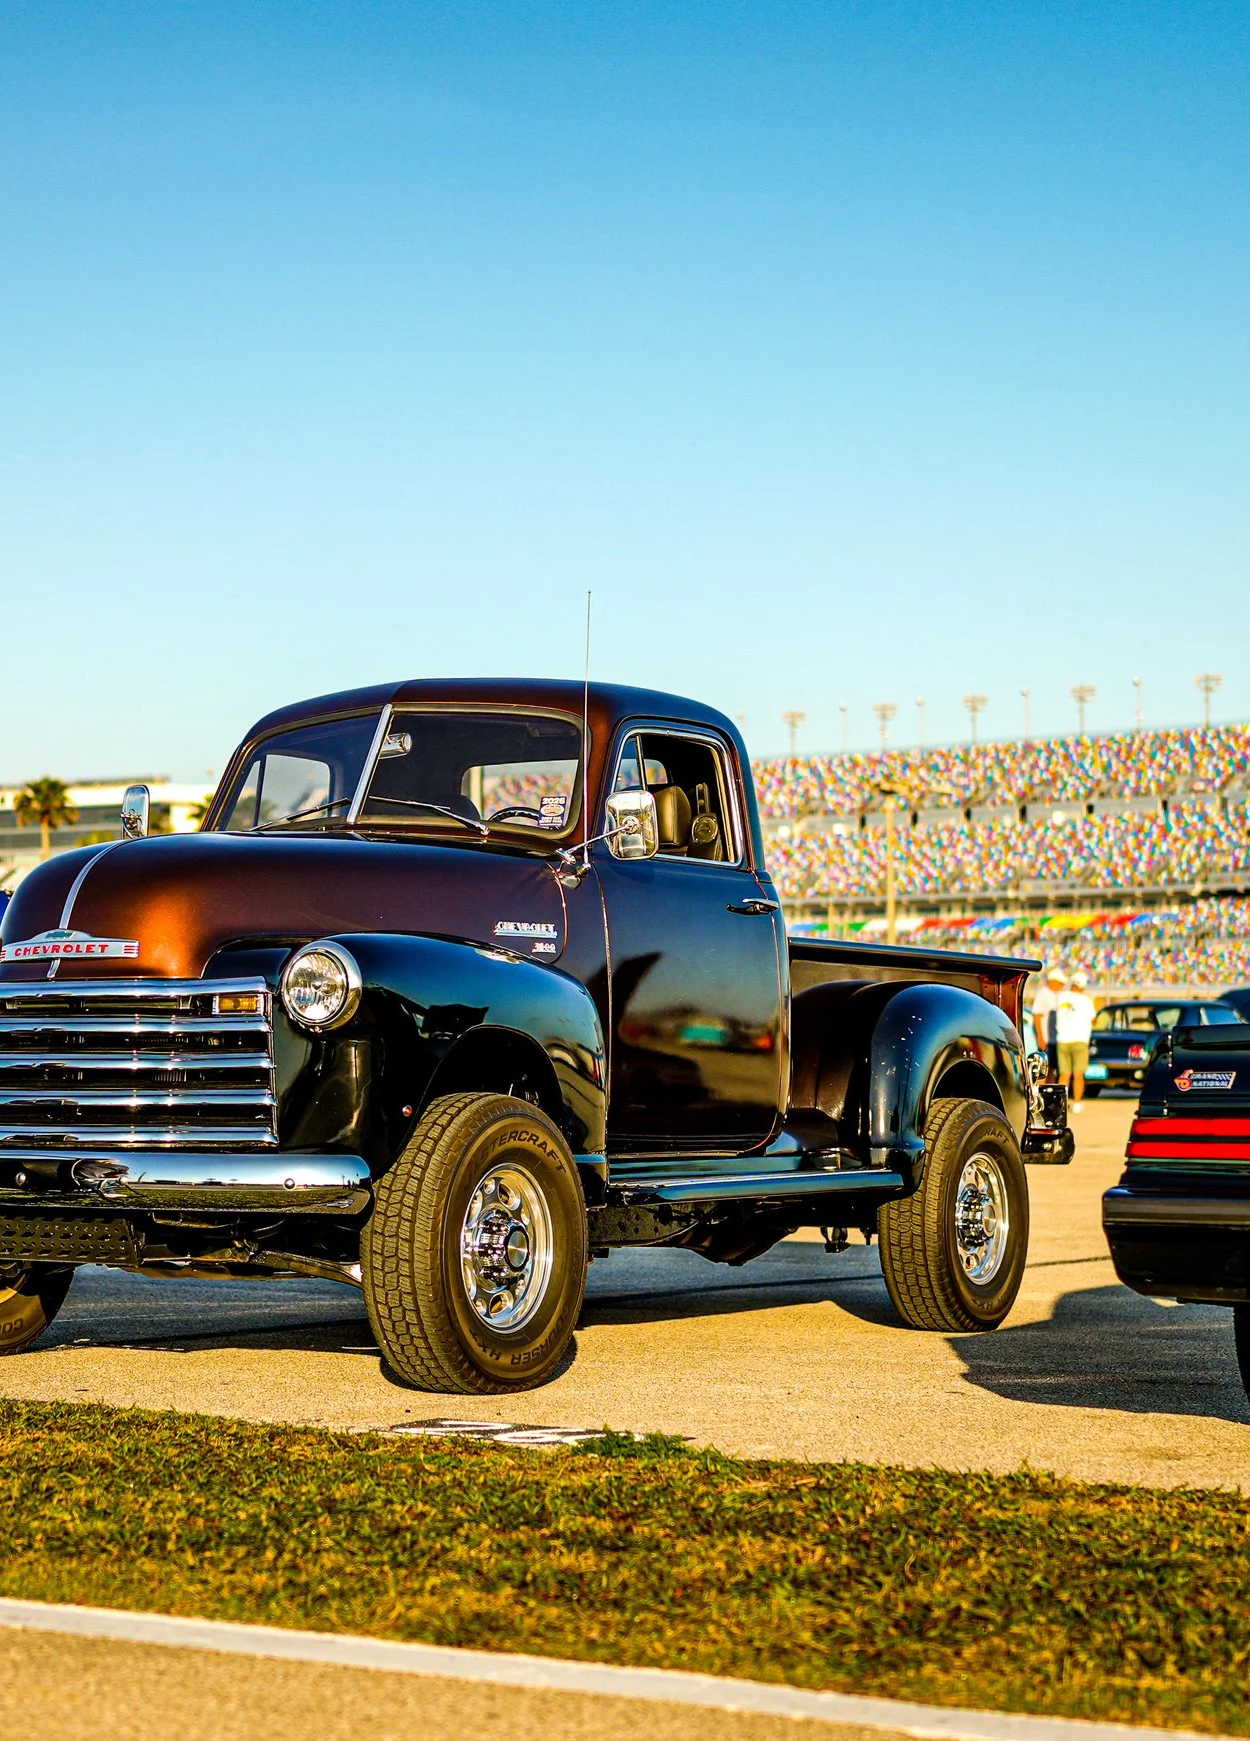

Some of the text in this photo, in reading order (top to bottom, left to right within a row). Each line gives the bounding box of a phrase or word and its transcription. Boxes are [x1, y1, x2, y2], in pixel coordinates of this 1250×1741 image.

[542, 797, 566, 805] 2026
[495, 921, 554, 933] CHEVROLET
[14, 944, 109, 957] CHEVROLET
